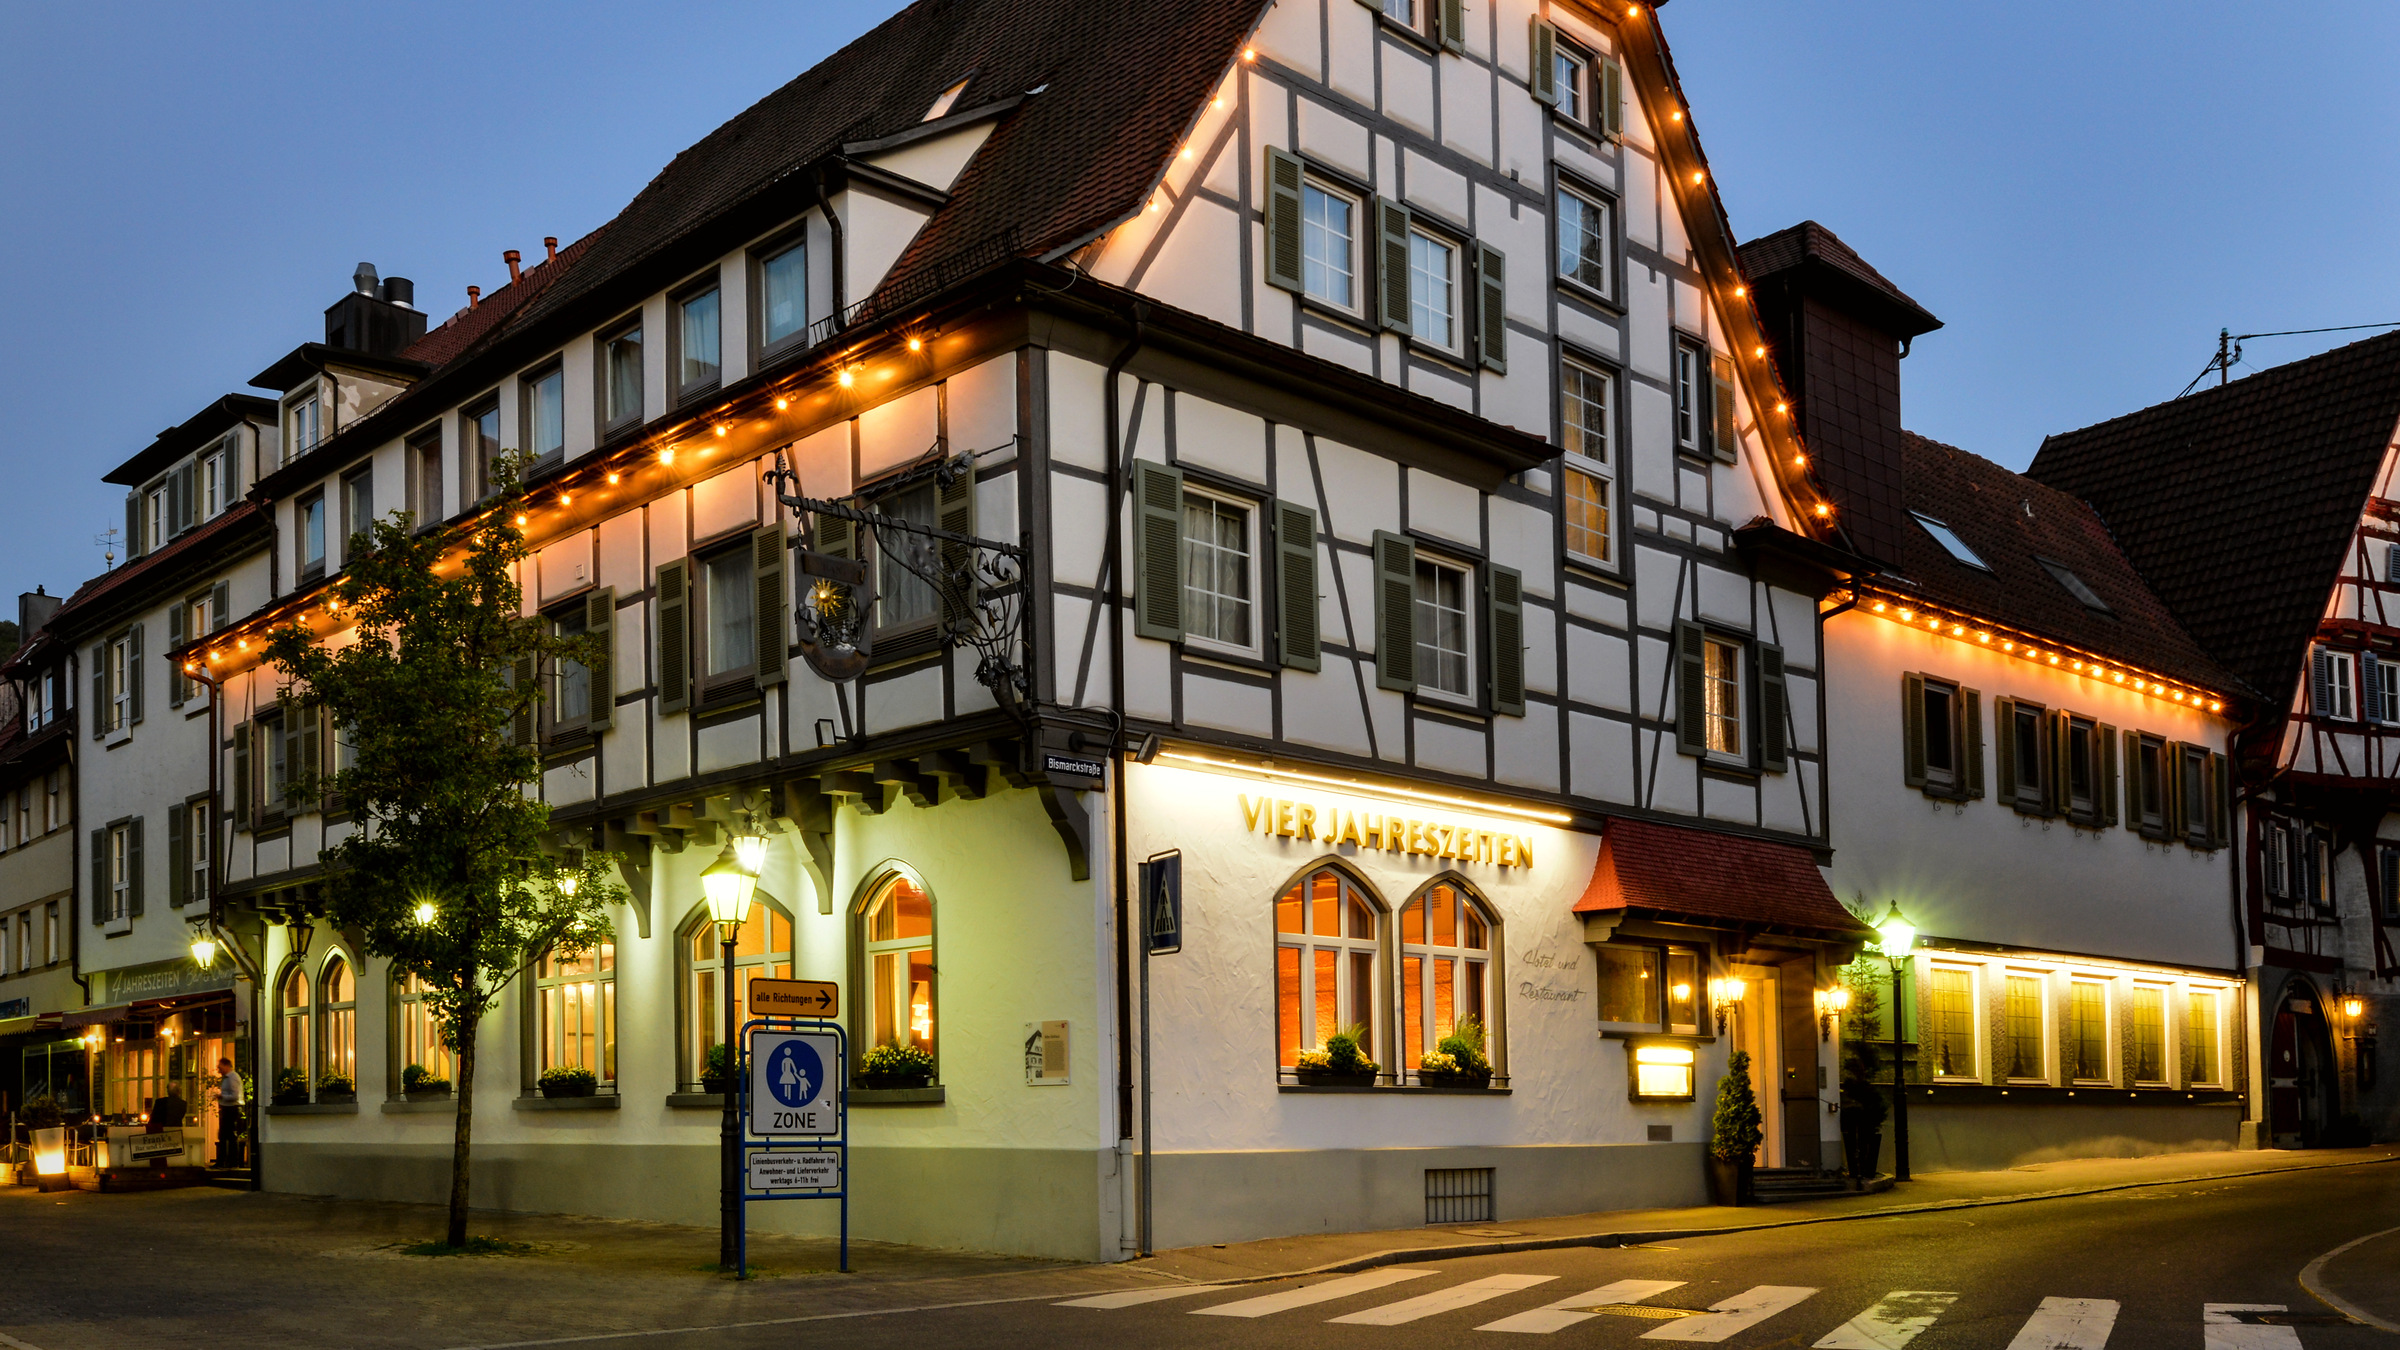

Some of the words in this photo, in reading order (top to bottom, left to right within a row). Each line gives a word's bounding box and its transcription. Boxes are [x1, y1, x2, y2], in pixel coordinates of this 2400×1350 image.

[1048, 757, 1101, 776] Bismarckstraße
[1237, 793, 1317, 841] VIER
[1323, 807, 1534, 869] JAHRESZEITEN
[1522, 949, 1556, 969] Hotel
[1557, 954, 1581, 970] und
[112, 971, 123, 1002] 4
[122, 970, 180, 994] JAHRESZEITEN
[1519, 981, 1587, 1002] Restaurant
[756, 992, 770, 1002] alle
[773, 992, 813, 1006] Richtungen
[773, 1112, 816, 1128] ZONE
[752, 1157, 796, 1165] Linienbusverkehr-
[827, 1156, 836, 1164] frei
[797, 1167, 830, 1175] Lieferverkehr
[770, 1177, 793, 1185] werktags
